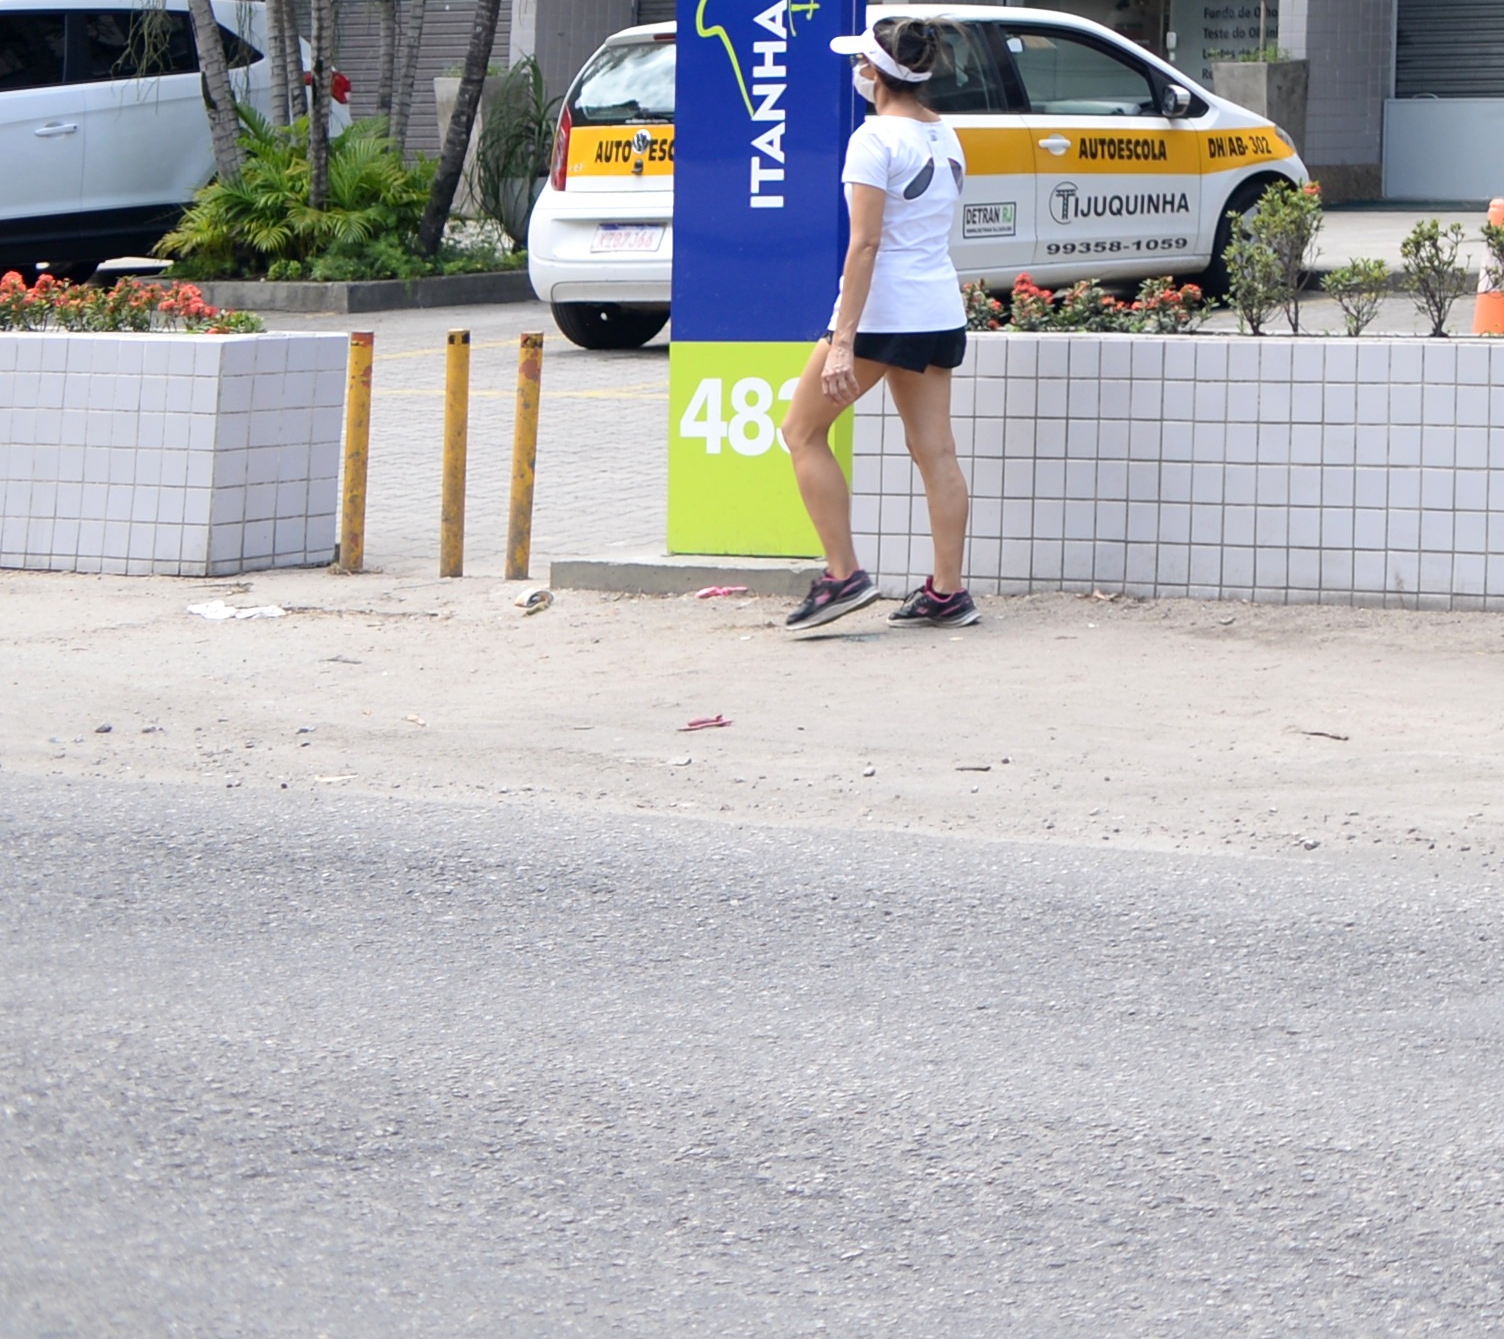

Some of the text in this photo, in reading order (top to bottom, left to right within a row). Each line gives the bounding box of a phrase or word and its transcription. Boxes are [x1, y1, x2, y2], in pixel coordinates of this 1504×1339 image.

[1203, 6, 1236, 20] Fundo
[1202, 27, 1230, 41] Teste
[595, 140, 632, 163] AUTO
[1078, 137, 1168, 161] AUTOESCOLA
[1250, 135, 1272, 155] 302
[964, 202, 1014, 225] DETRAN RJ
[1053, 186, 1190, 222] TIJUQUINHA
[1046, 237, 1188, 255] 99358-1059
